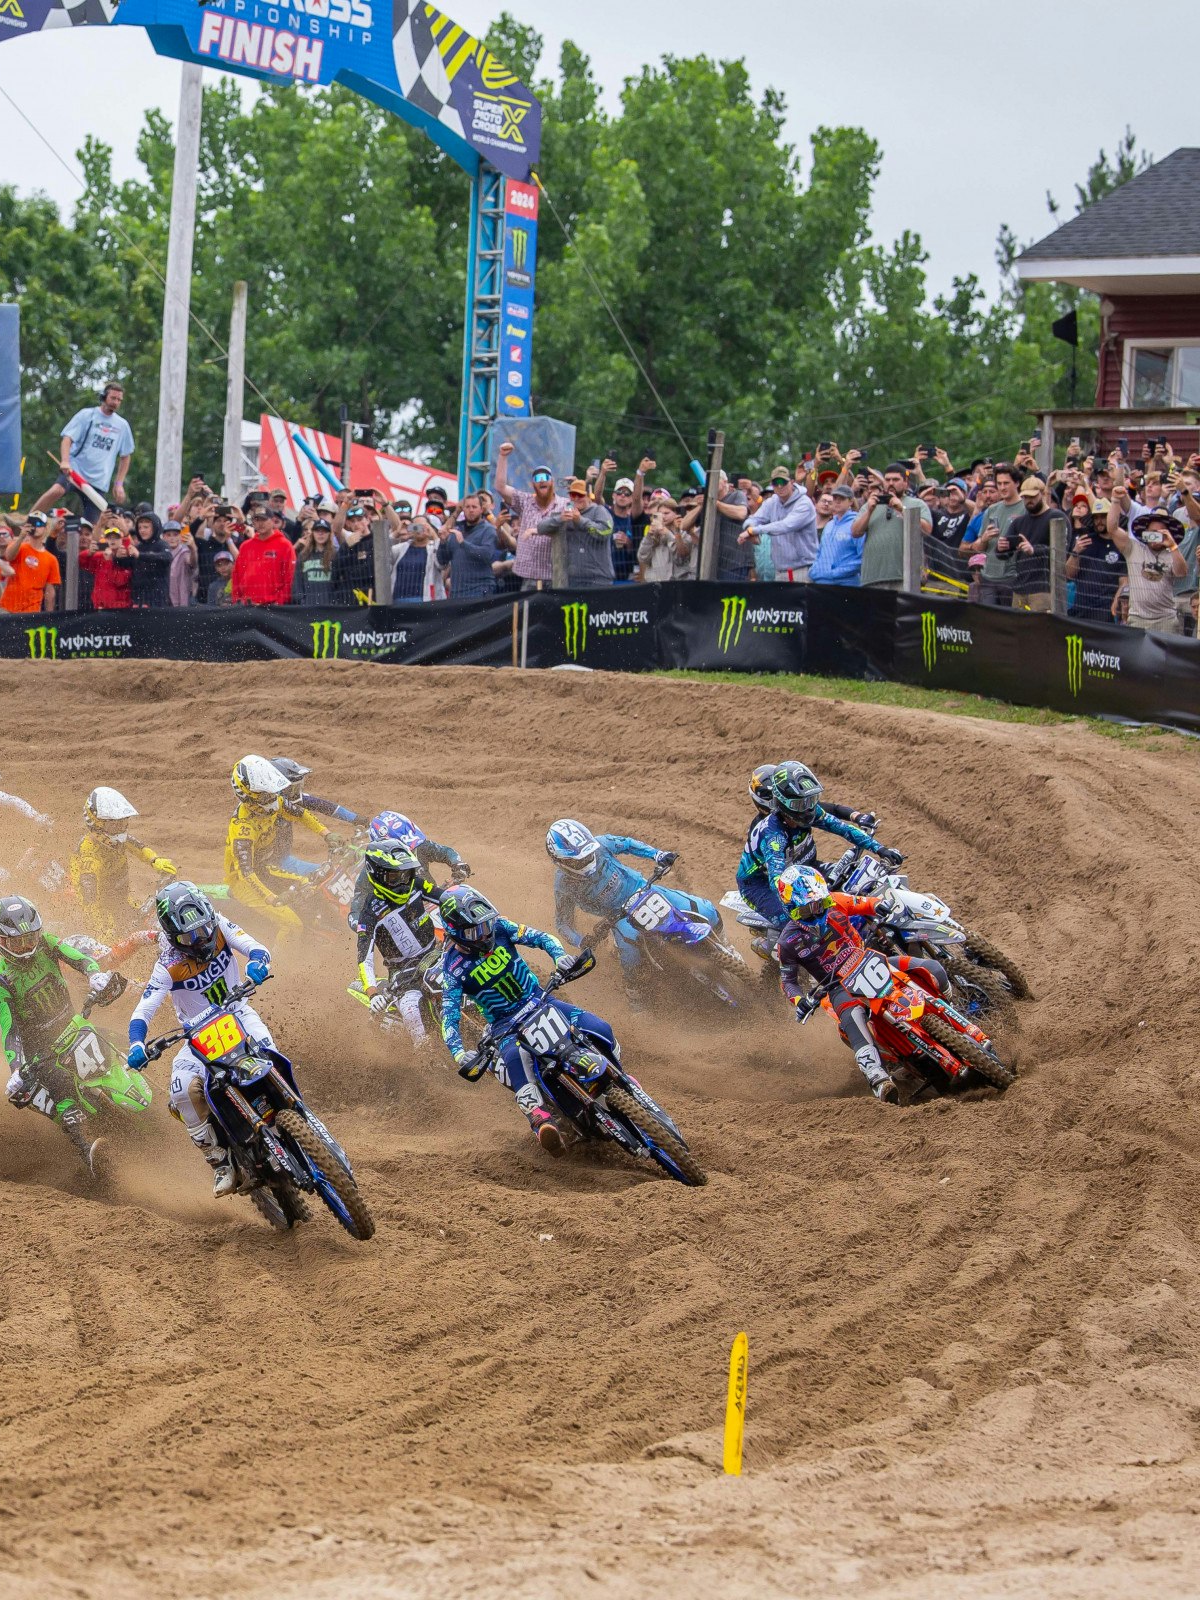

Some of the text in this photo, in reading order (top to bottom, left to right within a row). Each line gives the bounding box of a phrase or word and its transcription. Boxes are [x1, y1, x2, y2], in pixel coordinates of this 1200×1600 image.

[199, 10, 324, 81] FINISH
[475, 109, 503, 125] MOTO
[511, 189, 535, 210] 2024
[589, 610, 649, 627] MONSTER
[745, 607, 804, 625] MONSTER
[342, 630, 407, 647] MONSTER
[597, 626, 640, 636] ENERGY
[752, 625, 795, 634] ENERGY
[936, 624, 974, 645] MONSTER
[60, 633, 132, 651] MONSTER
[941, 643, 969, 653] ENERGY
[1082, 649, 1121, 671] MONSTER
[1088, 667, 1115, 681] ENERGY
[238, 825, 251, 836] 35
[635, 893, 671, 931] 99
[469, 946, 512, 986] THOR
[852, 956, 890, 998] 16
[198, 1014, 242, 1061] 38
[525, 1007, 568, 1054] 511
[74, 1032, 105, 1080] 47
[305, 1110, 334, 1144] DUNLOP
[595, 1113, 626, 1143] DUNLOP
[264, 1137, 291, 1172] DUNLOP
